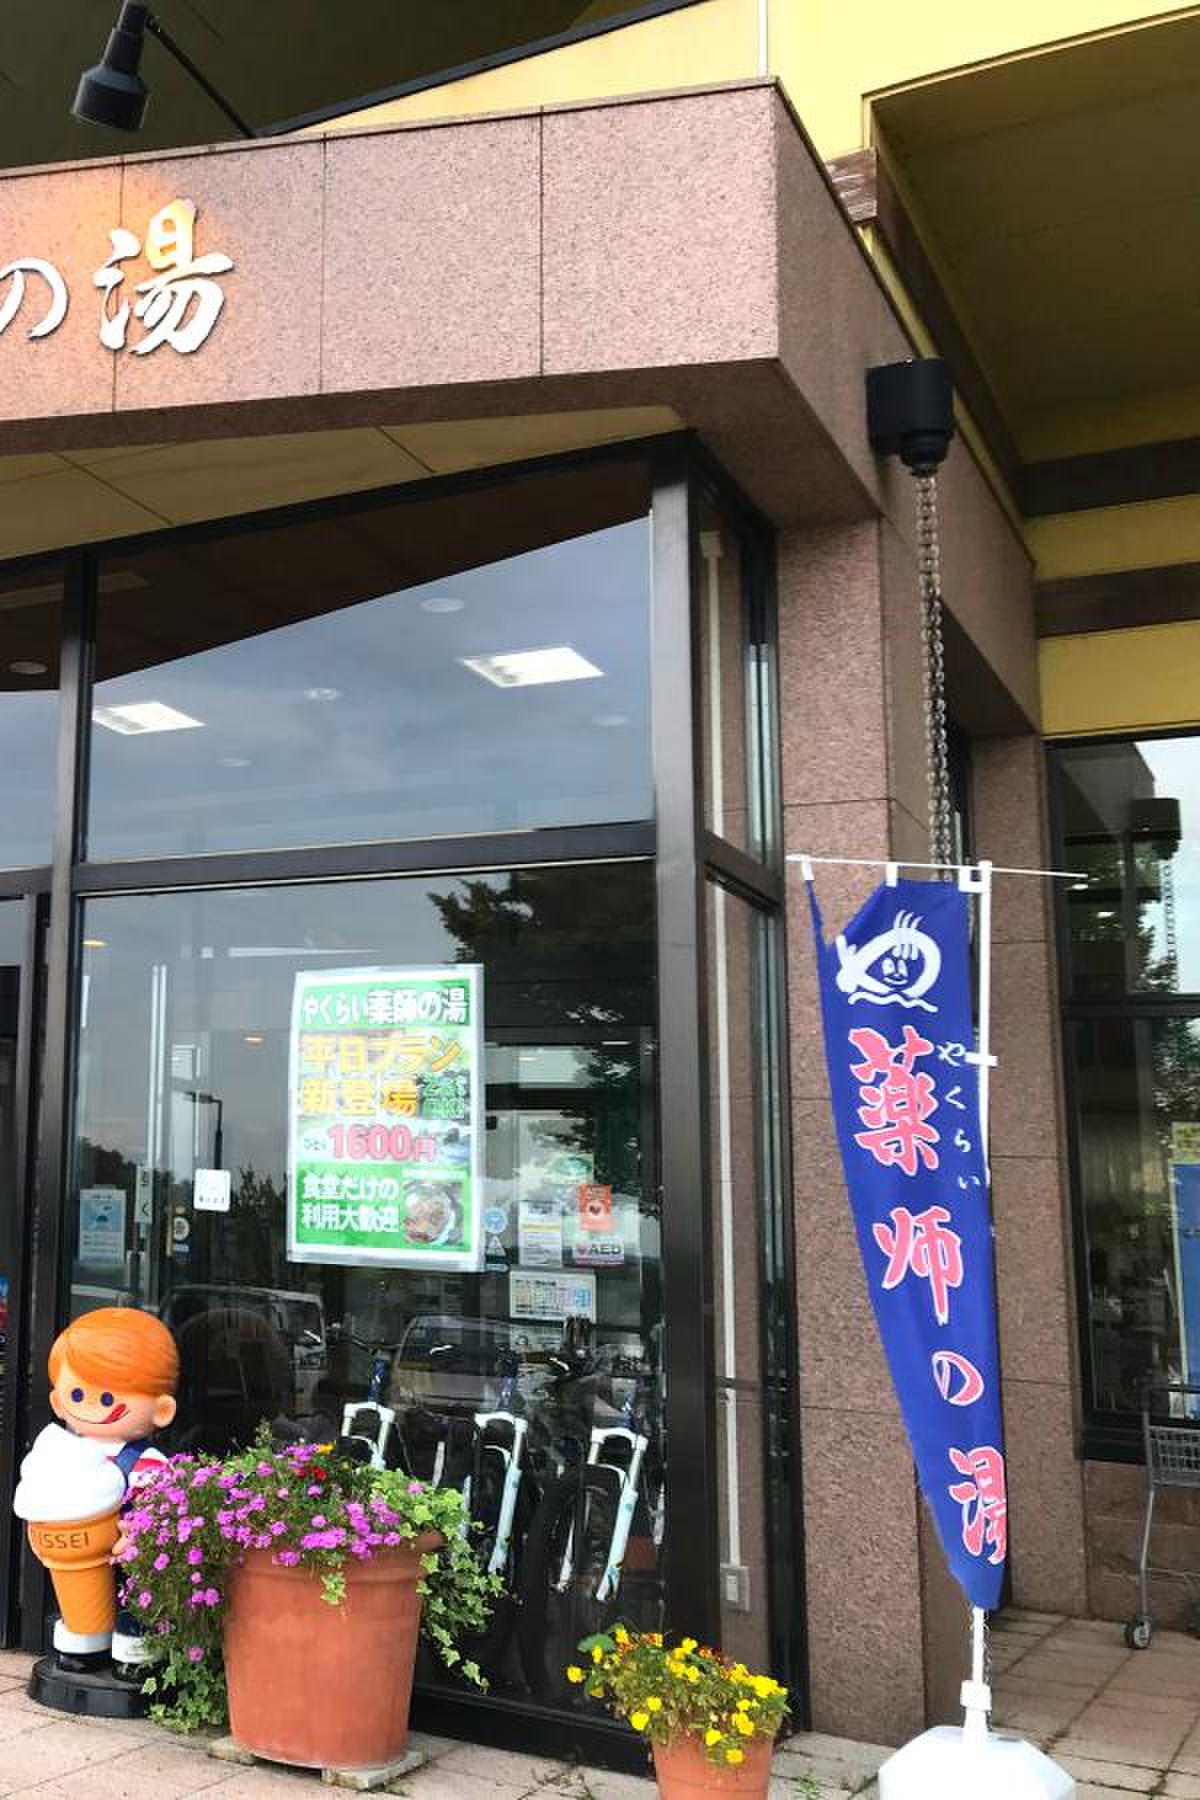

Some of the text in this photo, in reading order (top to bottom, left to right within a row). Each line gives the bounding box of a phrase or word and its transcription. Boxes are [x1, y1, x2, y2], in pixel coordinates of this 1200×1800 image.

[302, 1033, 463, 1074] 平日プラン
[302, 1172, 400, 1200] 食堂だけの
